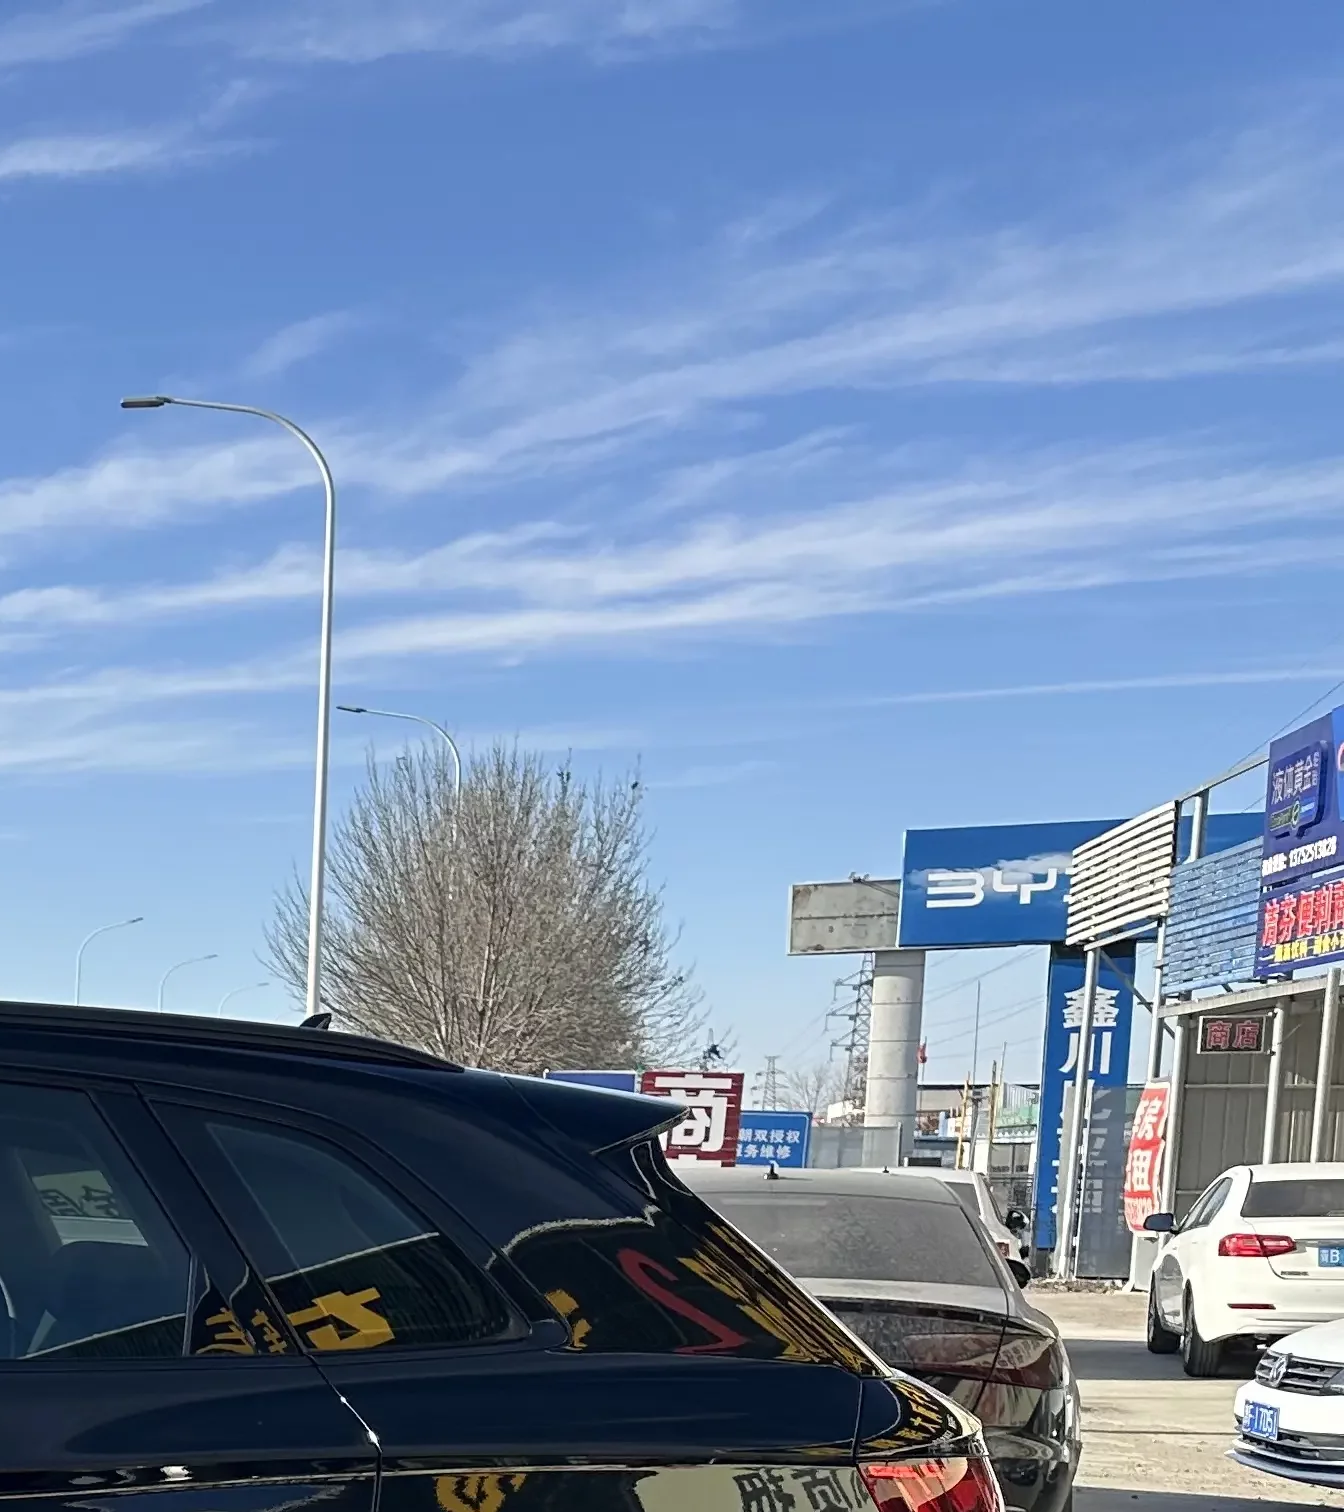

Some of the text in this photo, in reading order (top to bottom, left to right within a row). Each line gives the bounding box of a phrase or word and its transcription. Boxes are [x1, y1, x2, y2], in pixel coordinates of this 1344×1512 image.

[926, 868, 1075, 909] BY
[1206, 1020, 1260, 1049] 商店
[655, 1074, 733, 1167] 商
